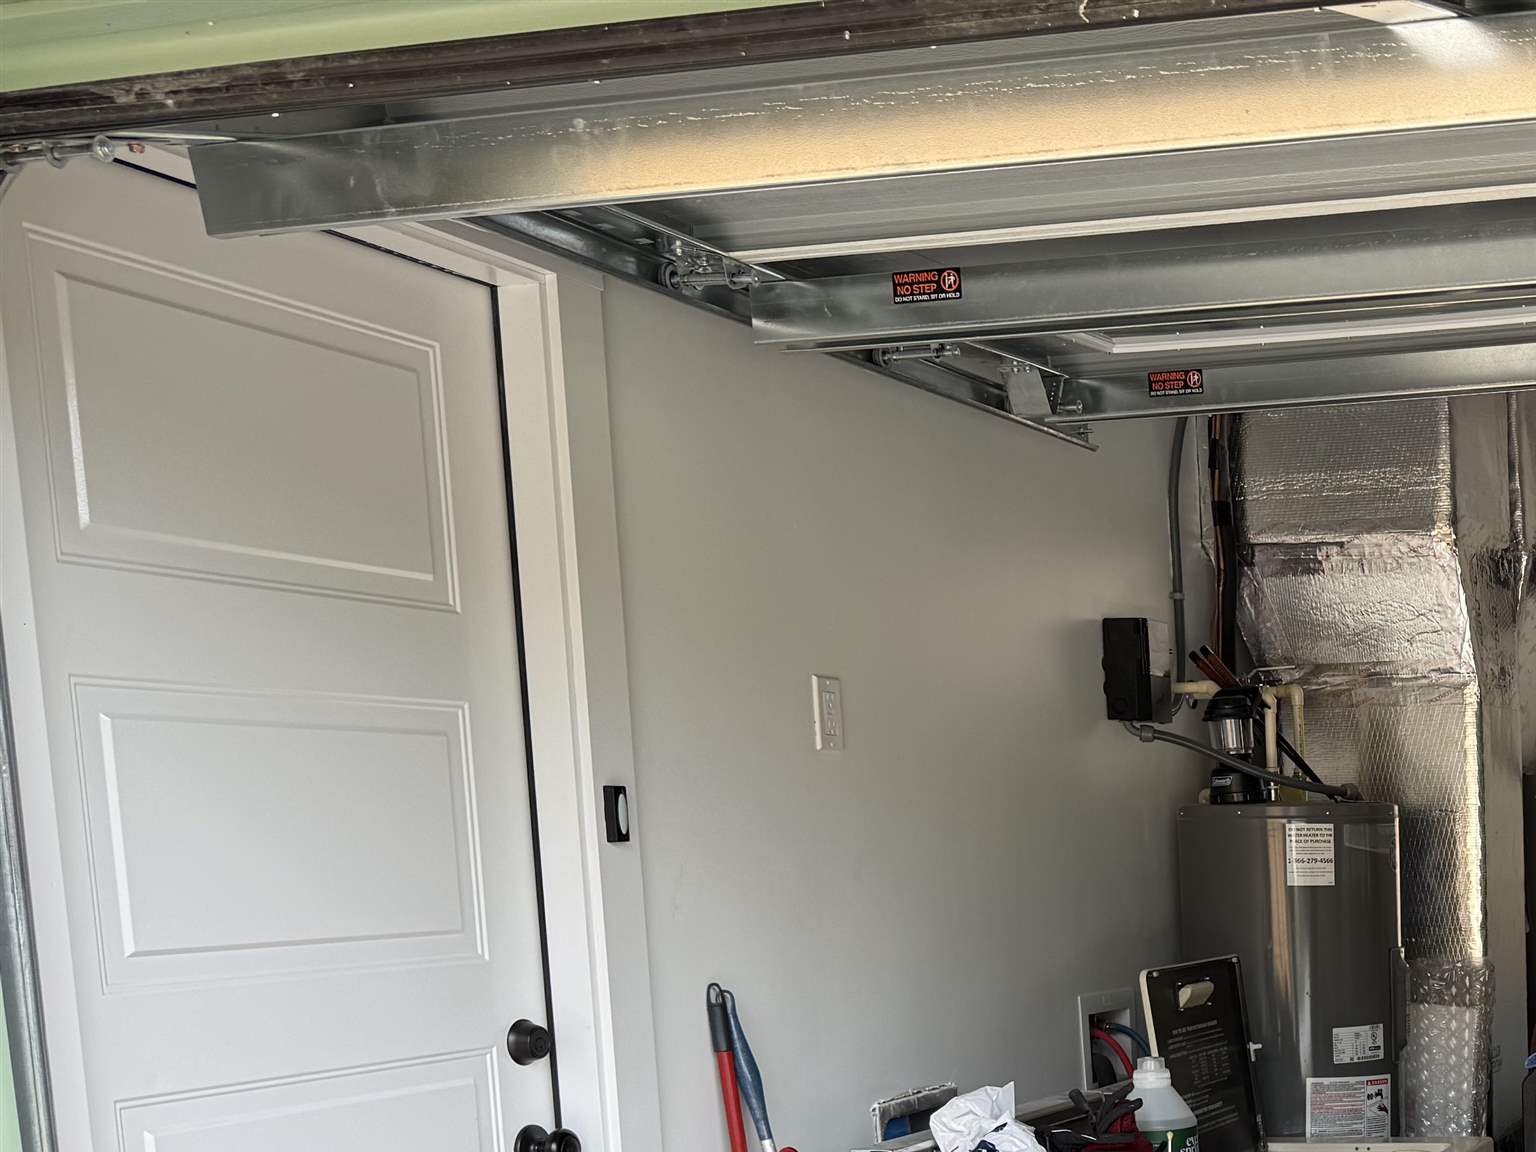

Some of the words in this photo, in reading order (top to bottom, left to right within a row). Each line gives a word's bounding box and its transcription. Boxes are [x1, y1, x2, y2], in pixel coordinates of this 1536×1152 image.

[894, 271, 938, 284] WARNING
[897, 285, 911, 295] NO
[913, 283, 937, 294] STEP
[1150, 371, 1185, 382] WARNING
[1152, 382, 1164, 390] NO
[1165, 381, 1184, 390] STEP
